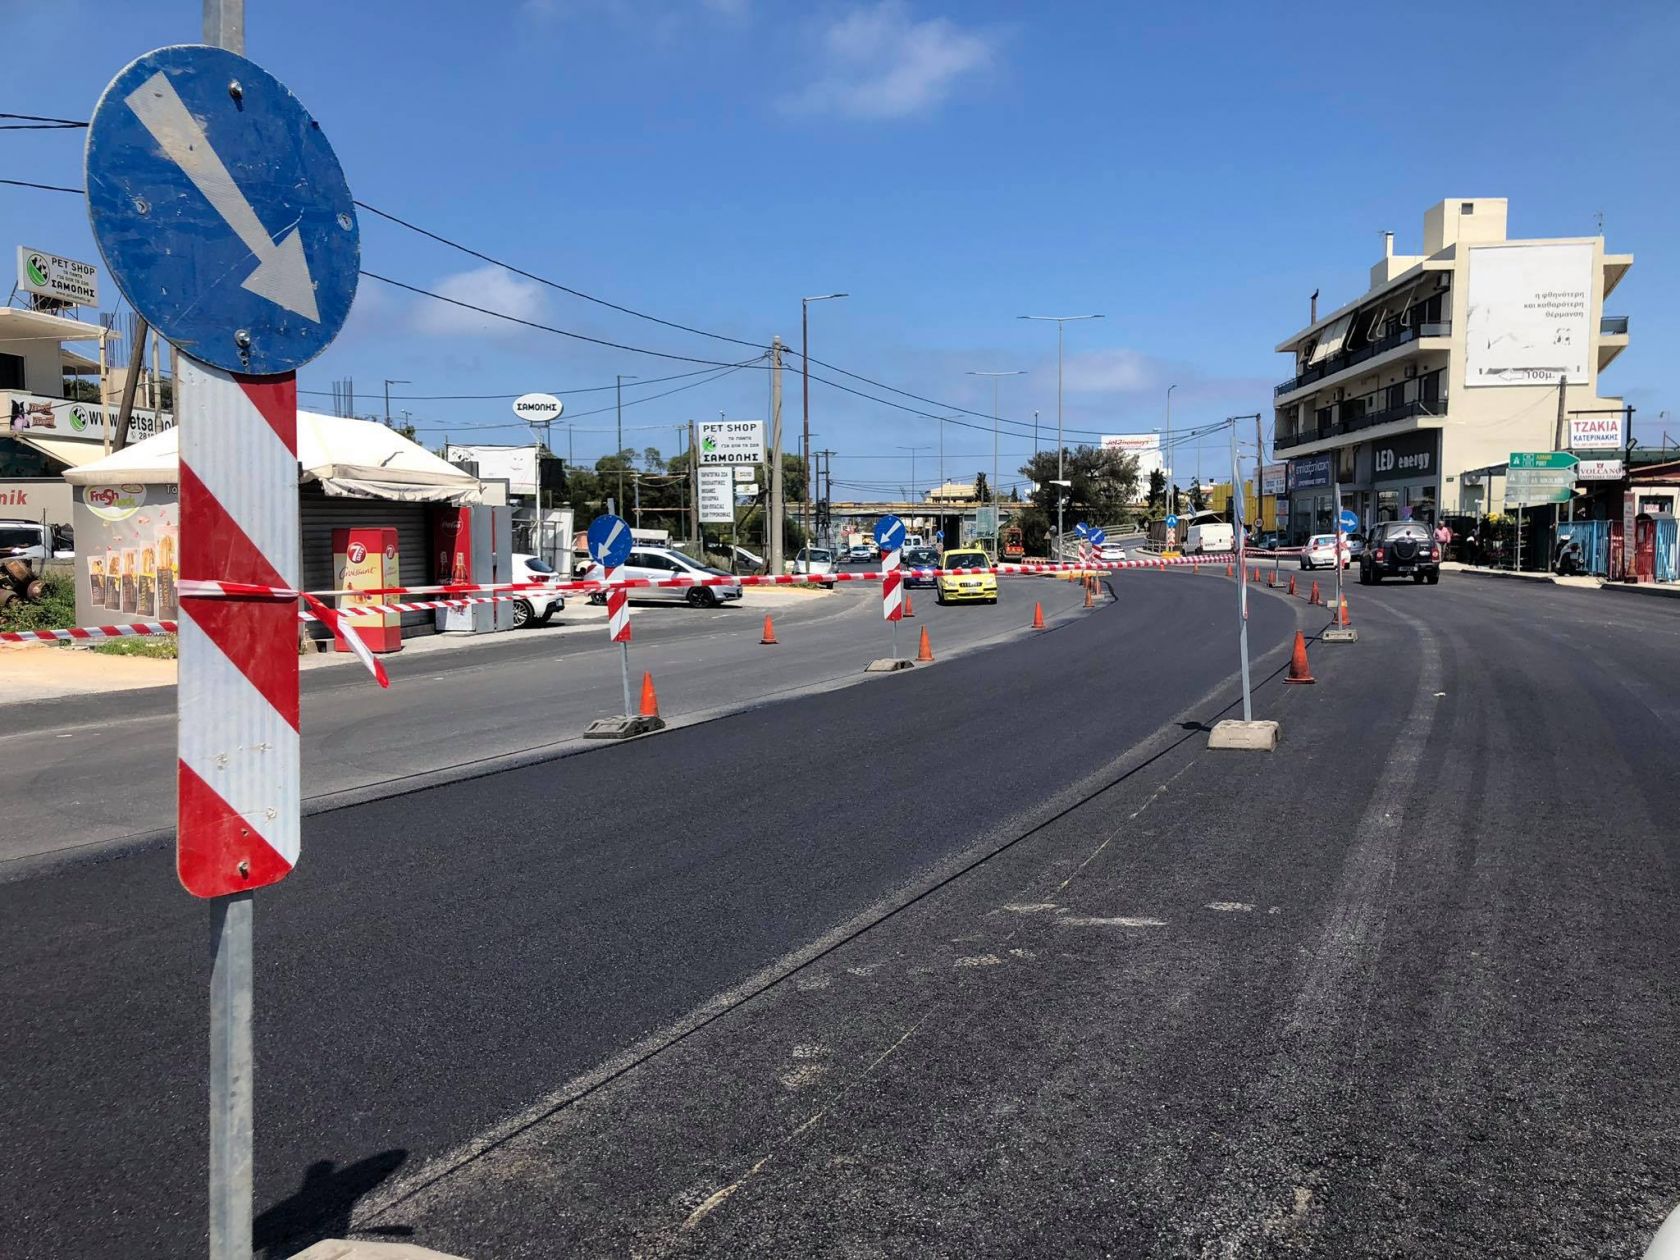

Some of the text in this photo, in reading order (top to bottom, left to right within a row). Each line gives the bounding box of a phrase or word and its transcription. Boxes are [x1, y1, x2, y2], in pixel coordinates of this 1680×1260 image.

[51, 257, 95, 275] PET SHOP
[703, 423, 757, 433] PET SHOP
[1573, 420, 1618, 433] ΤΖΑΚΙΑ
[1573, 434, 1618, 442] ΚΑΤΕΡΙΝΑΚΗΣ
[1375, 449, 1430, 472] LED energy
[90, 488, 119, 505] Fresh
[350, 545, 361, 561] 7
